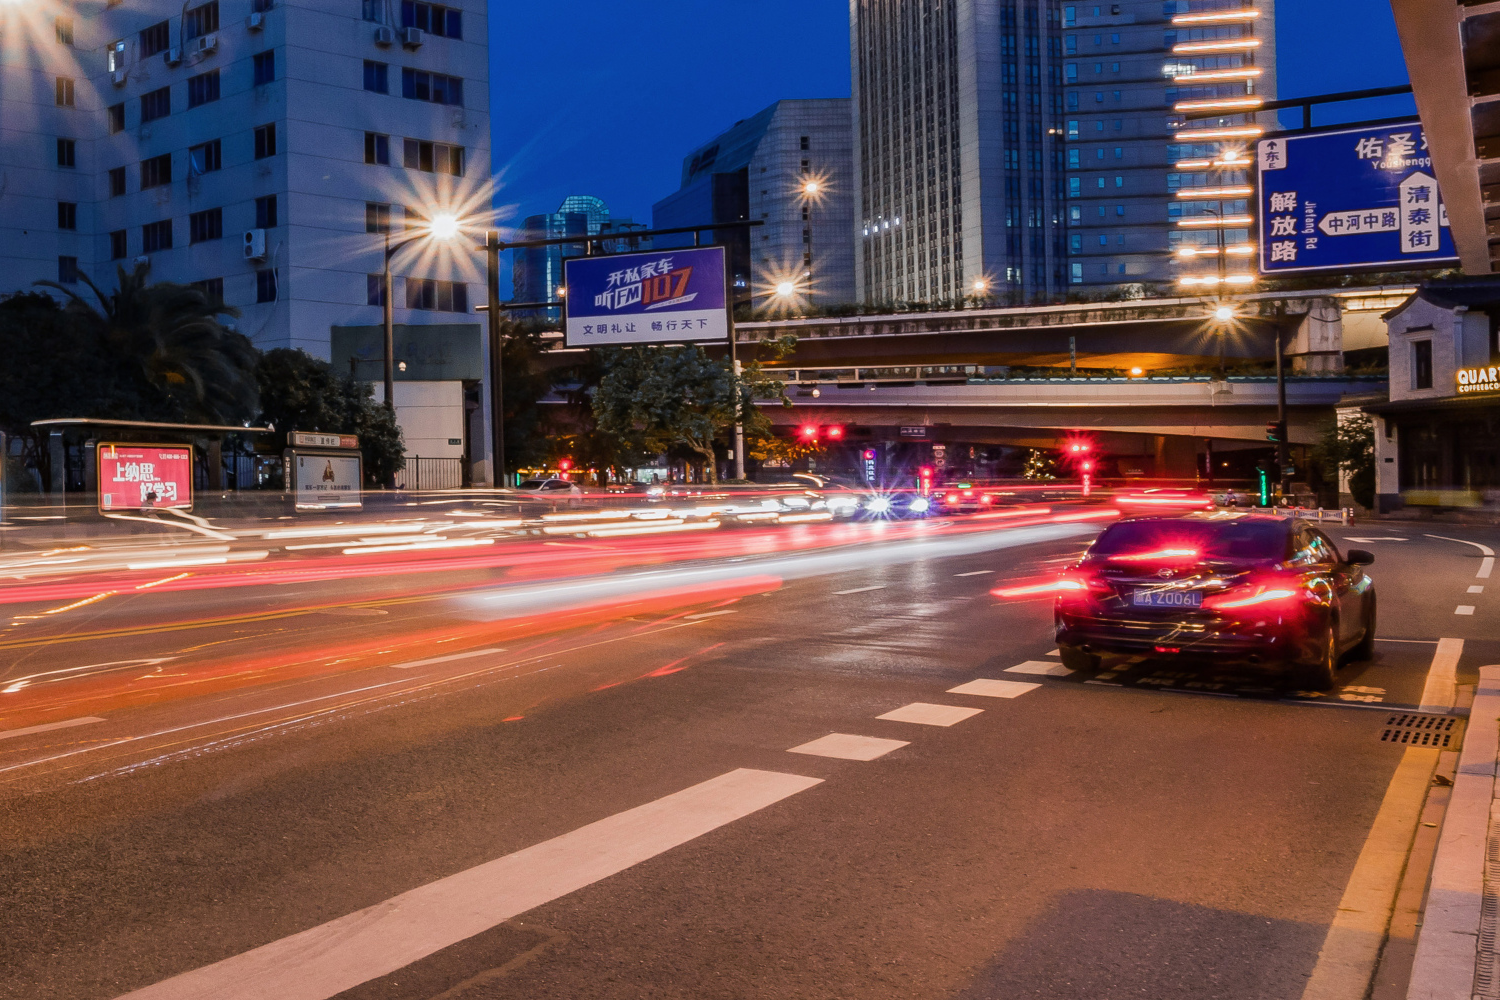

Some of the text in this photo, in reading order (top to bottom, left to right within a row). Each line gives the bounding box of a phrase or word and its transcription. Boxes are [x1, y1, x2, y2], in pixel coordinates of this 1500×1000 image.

[1265, 151, 1279, 161] 东
[1270, 191, 1298, 262] 解放路
[1302, 201, 1317, 249] Jiefang Rd
[1329, 212, 1396, 233] 中河中路
[1407, 185, 1432, 248] 清泰街
[606, 257, 674, 290] 开私家车
[583, 318, 708, 335] 文明礼让 畅行天下
[112, 462, 154, 482] 上纳思
